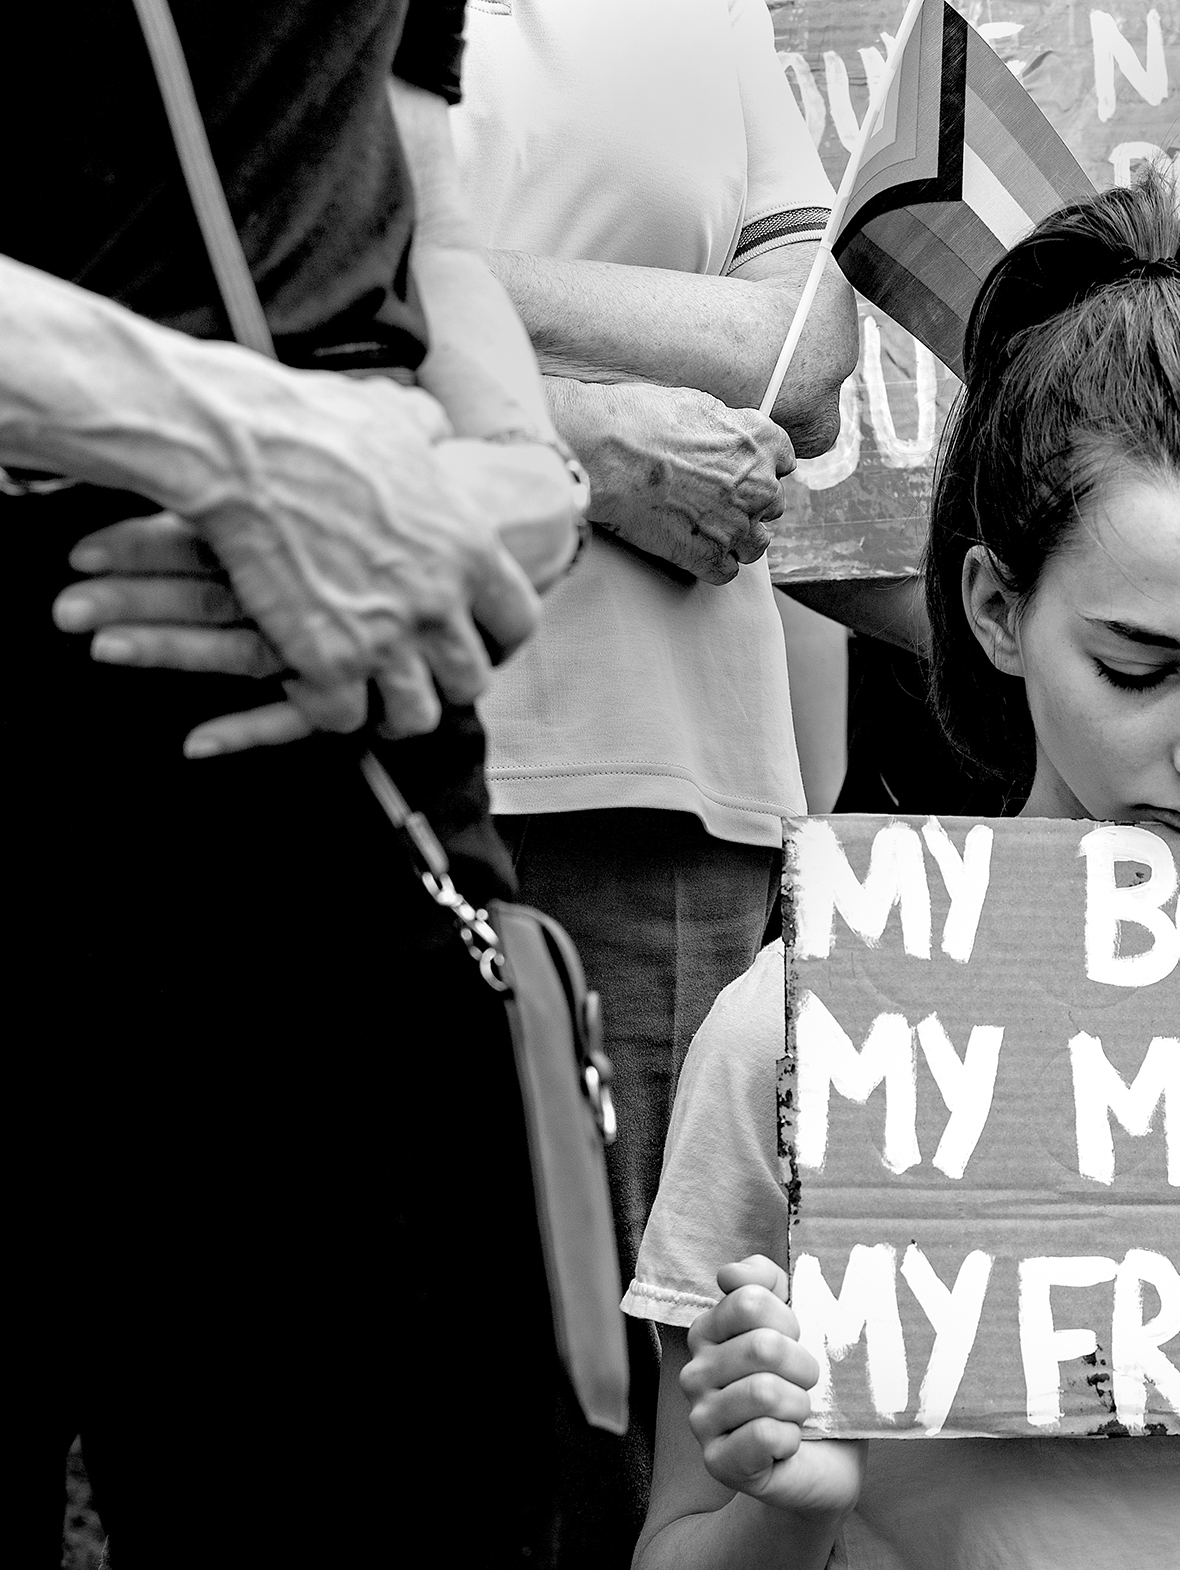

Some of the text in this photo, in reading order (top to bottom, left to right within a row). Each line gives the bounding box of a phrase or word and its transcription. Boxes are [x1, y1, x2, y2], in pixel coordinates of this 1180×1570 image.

[793, 815, 994, 964] MY
[793, 989, 1005, 1180] MY
[791, 1242, 996, 1436] MY
